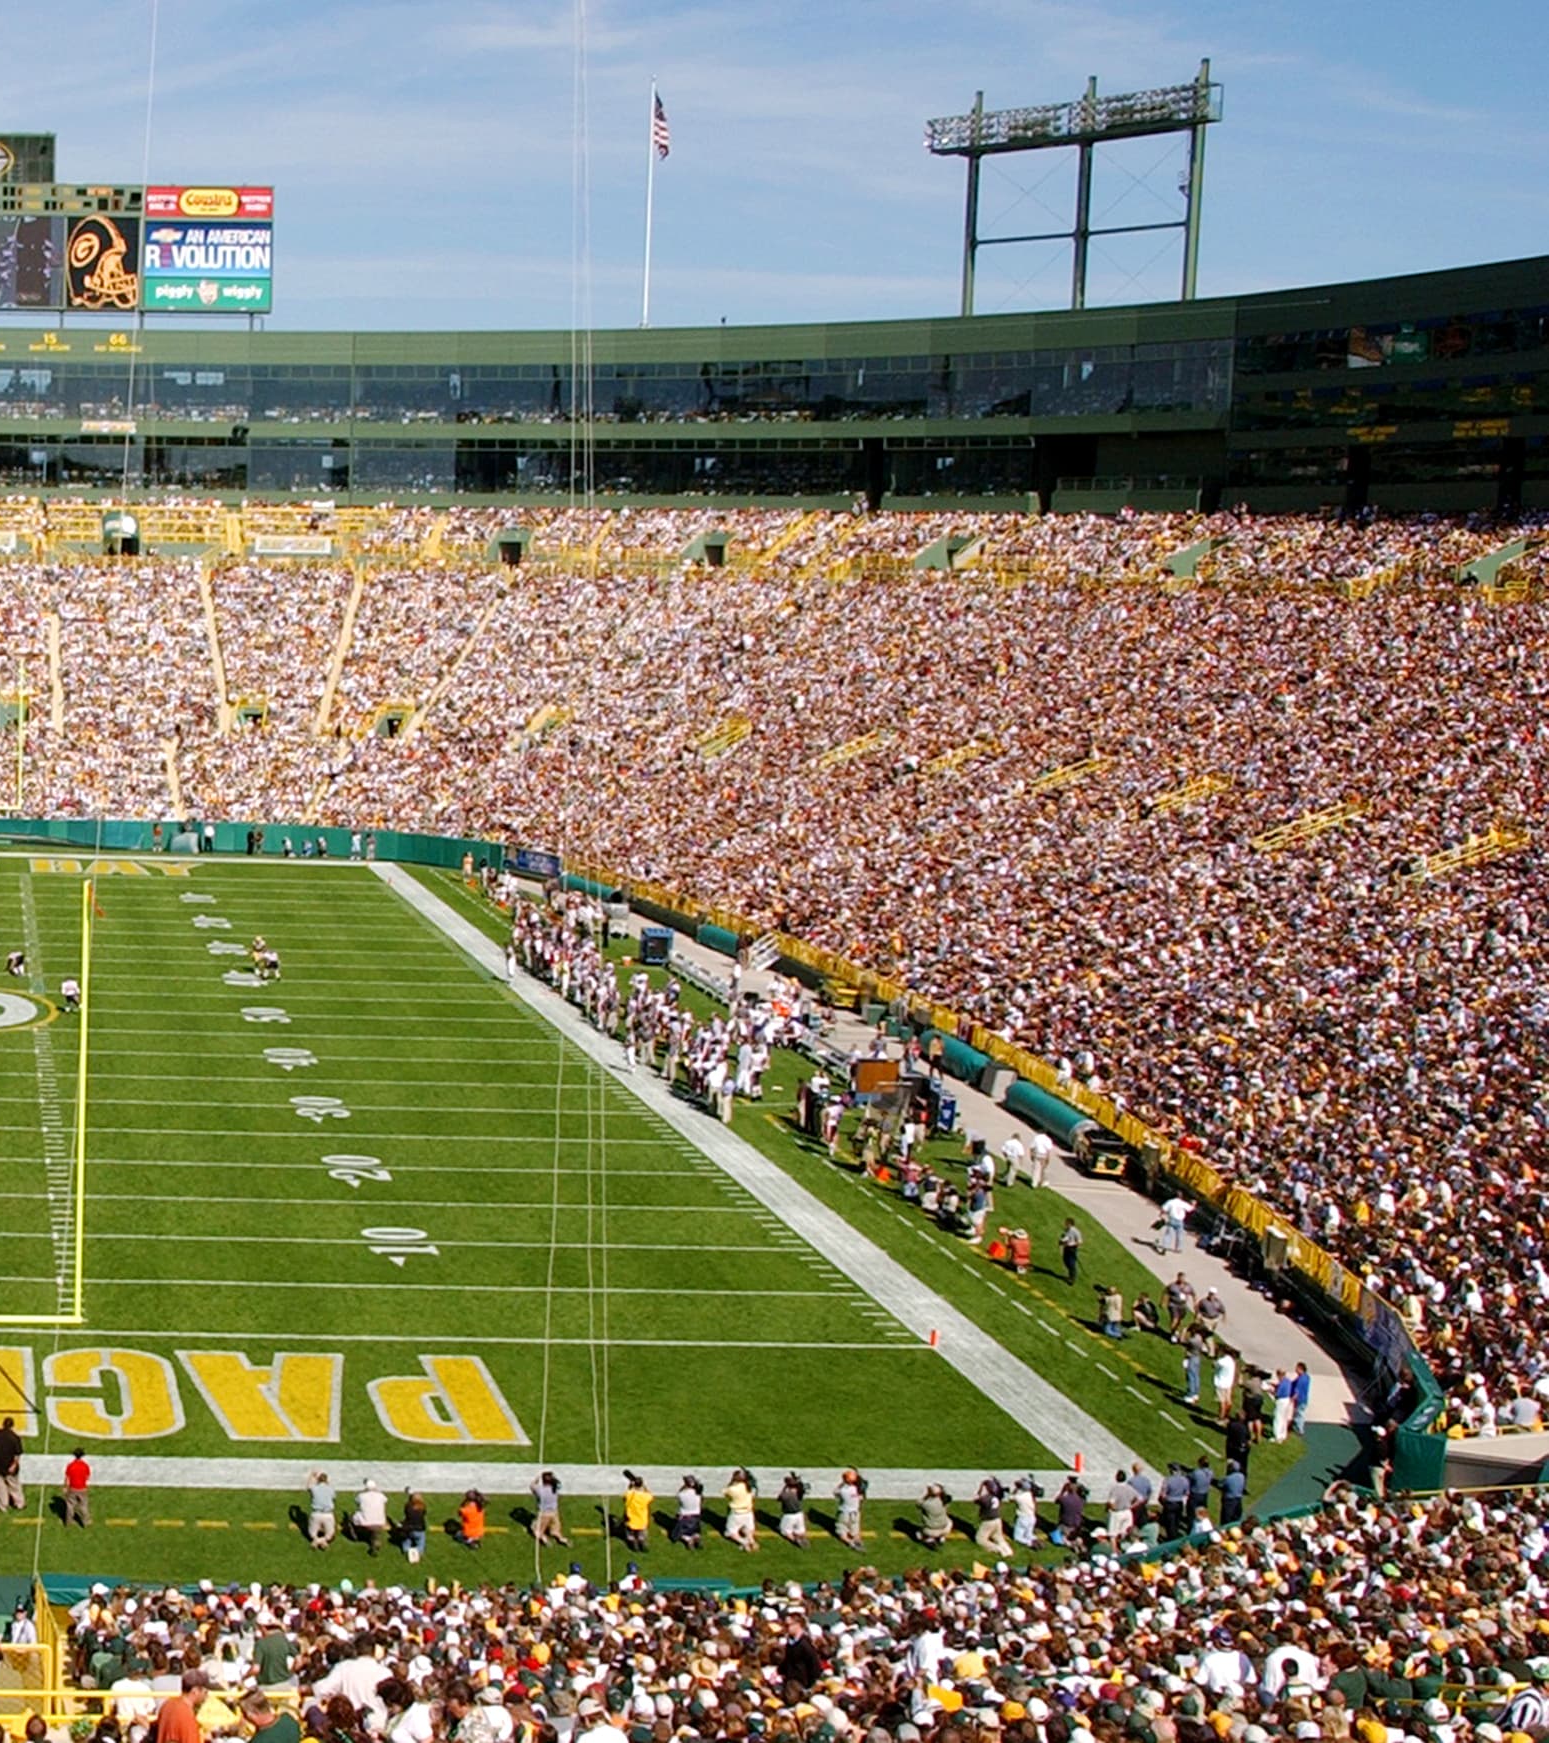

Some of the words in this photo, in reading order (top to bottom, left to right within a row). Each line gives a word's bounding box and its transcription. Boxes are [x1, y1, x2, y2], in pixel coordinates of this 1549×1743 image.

[185, 193, 233, 207] Cousins
[185, 229, 206, 244] AN
[206, 229, 271, 245] AMERICAN
[42, 331, 58, 345] 15
[108, 332, 128, 346] 66
[29, 857, 205, 878] BAY
[288, 1095, 352, 1118] 30
[320, 1154, 393, 1182] 20
[360, 1226, 440, 1256] 10
